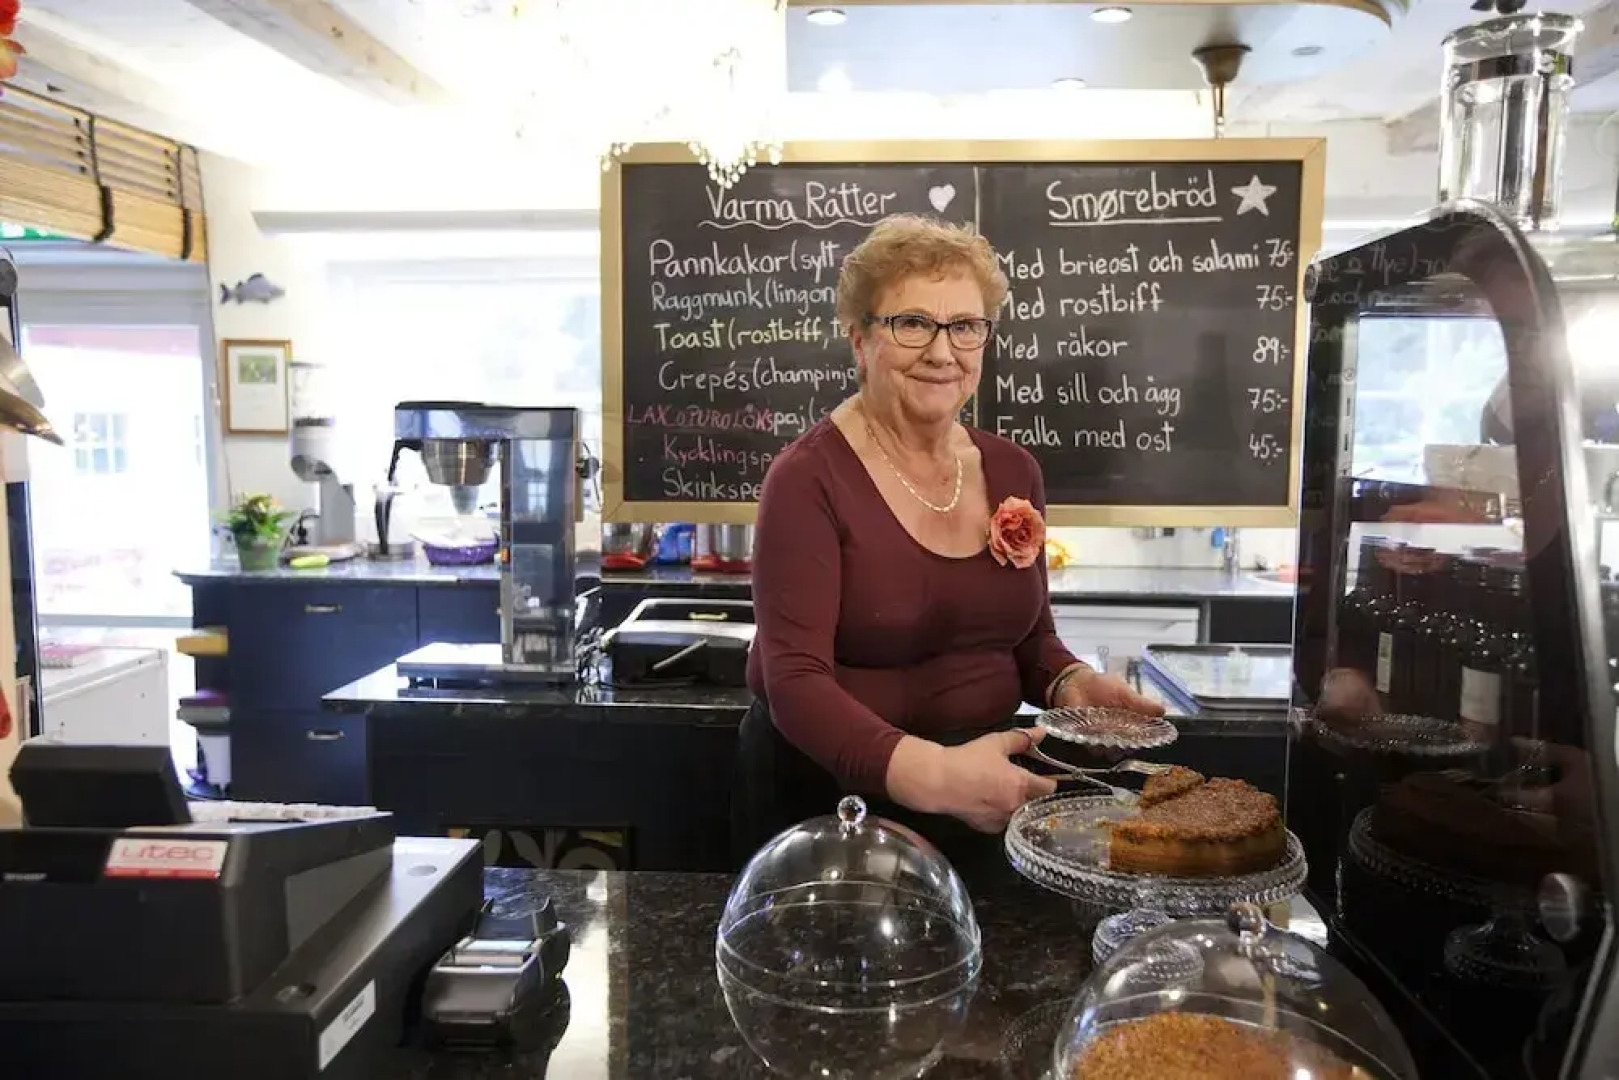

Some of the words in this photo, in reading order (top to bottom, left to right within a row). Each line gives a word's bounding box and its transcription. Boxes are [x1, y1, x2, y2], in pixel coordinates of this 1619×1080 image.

[705, 184, 799, 221] Varma
[806, 181, 897, 218] Rätter
[1046, 169, 1216, 220] Smørebröd
[996, 248, 1044, 279] Med
[1059, 245, 1139, 275] brieost
[1149, 241, 1183, 273] och
[1192, 239, 1259, 273] salami
[1059, 282, 1164, 317] rostbiff
[996, 333, 1039, 360] Med
[1057, 326, 1128, 357] räkor
[996, 374, 1043, 404] Med
[1057, 374, 1090, 405] sill
[1099, 375, 1138, 404] och
[1145, 377, 1181, 416] ägg
[996, 415, 1062, 446] Fralla
[1074, 420, 1126, 449] med
[1136, 421, 1175, 453] ost
